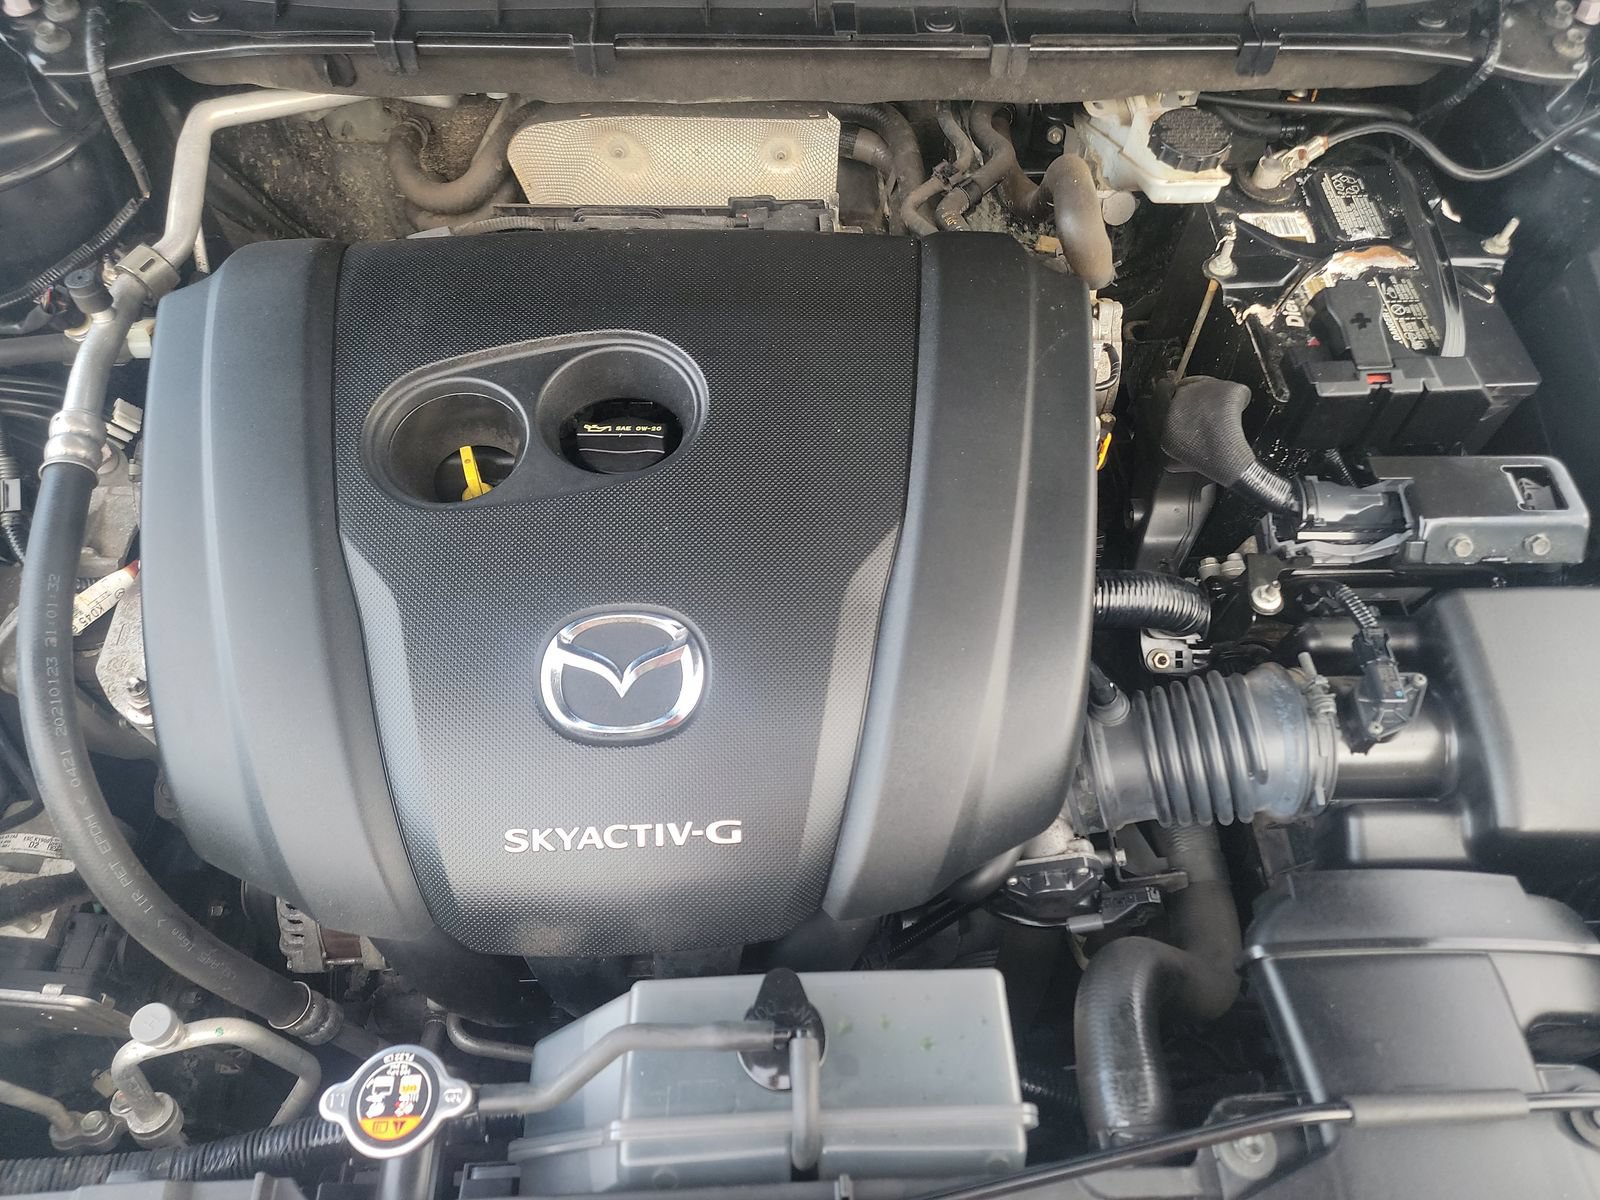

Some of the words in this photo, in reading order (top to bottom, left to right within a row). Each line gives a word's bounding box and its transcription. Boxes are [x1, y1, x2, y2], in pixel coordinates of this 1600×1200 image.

[46, 656, 68, 736] 20210123
[60, 749, 81, 788] 0421
[503, 819, 742, 853] SKYACTIV-G
